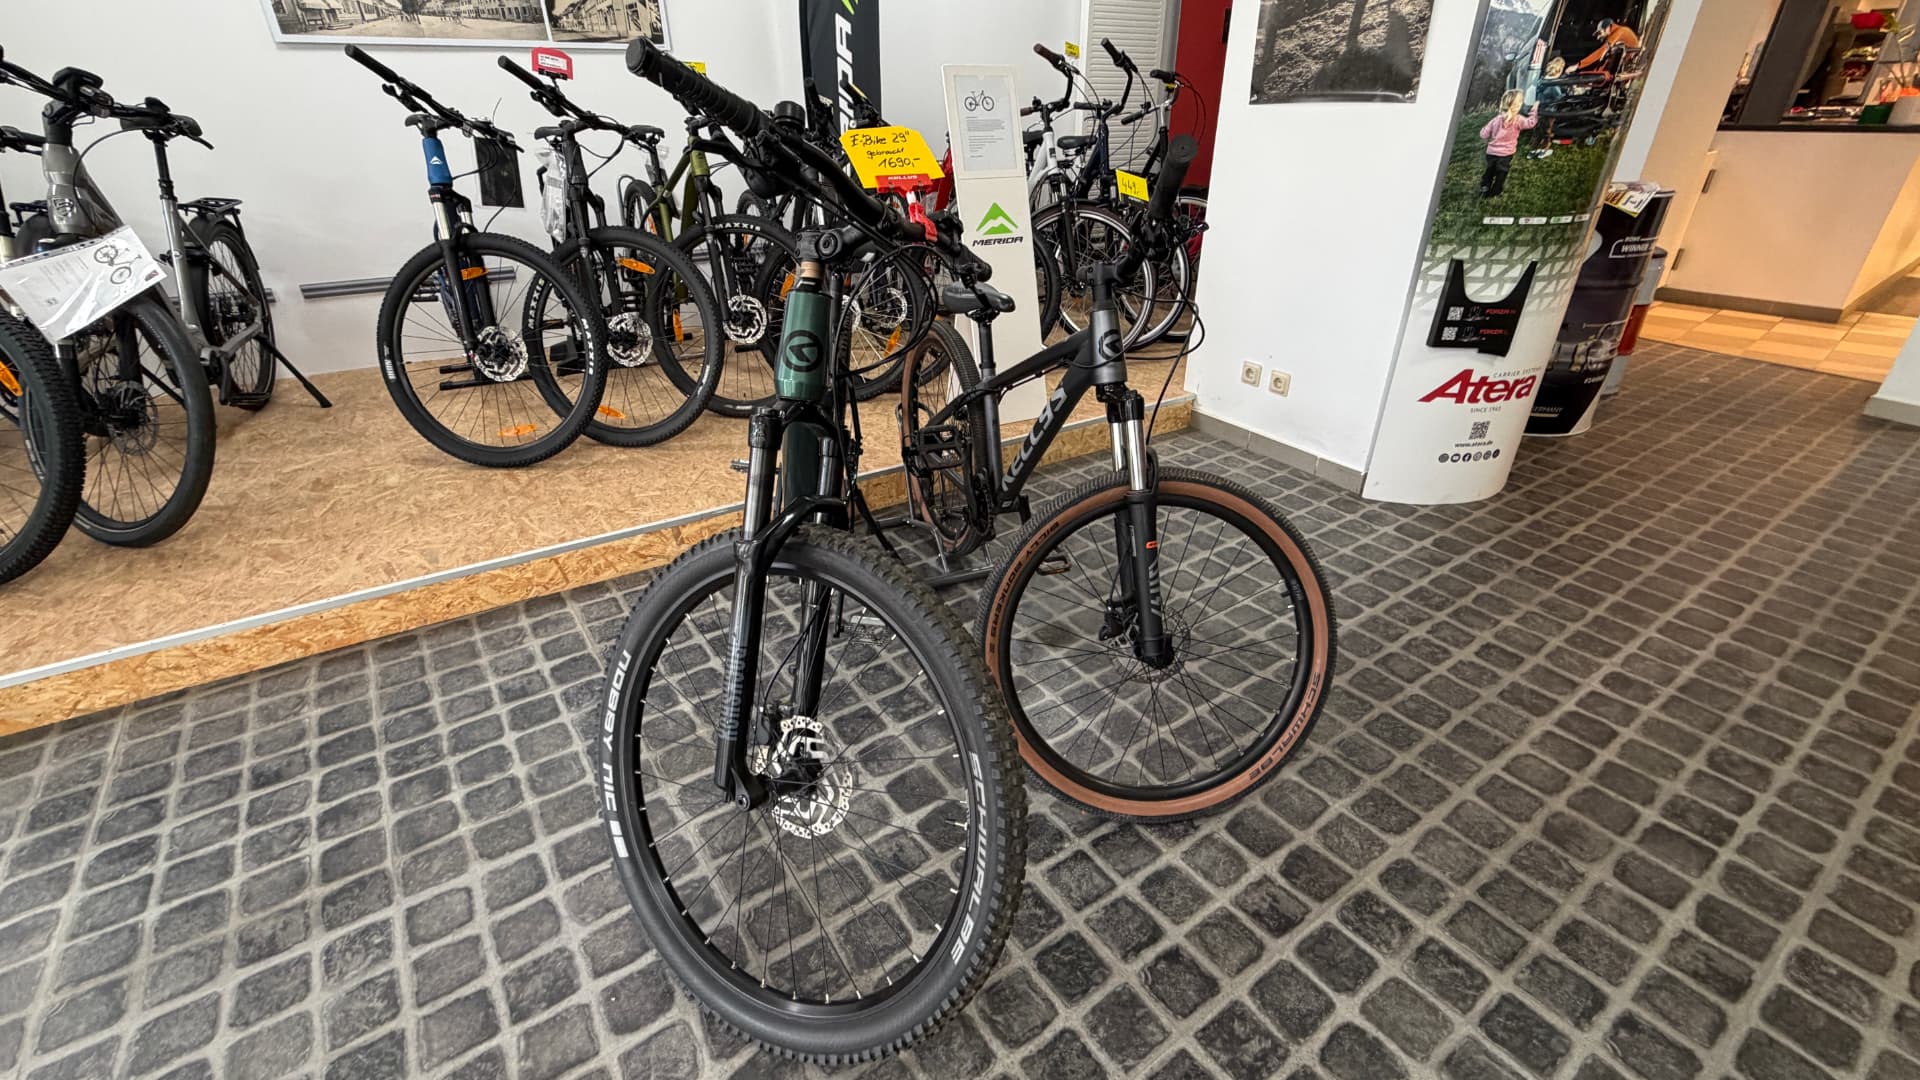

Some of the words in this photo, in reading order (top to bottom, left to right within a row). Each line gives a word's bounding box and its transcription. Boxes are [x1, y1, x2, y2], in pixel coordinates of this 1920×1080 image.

[849, 134, 887, 147] E-Bike
[866, 147, 904, 159] gebraucht
[714, 222, 761, 231] MAXXIS
[972, 235, 1024, 247] MERIDA
[527, 278, 545, 329] MAXXIS
[581, 318, 594, 375] MAXXIS
[1416, 369, 1536, 404] Atera
[1493, 370, 1520, 378] CARRIER
[602, 649, 632, 752] NOBBY
[1248, 671, 1322, 780] SCHWALBE
[602, 763, 618, 812] NIC
[950, 751, 987, 965] SCHWALBE
